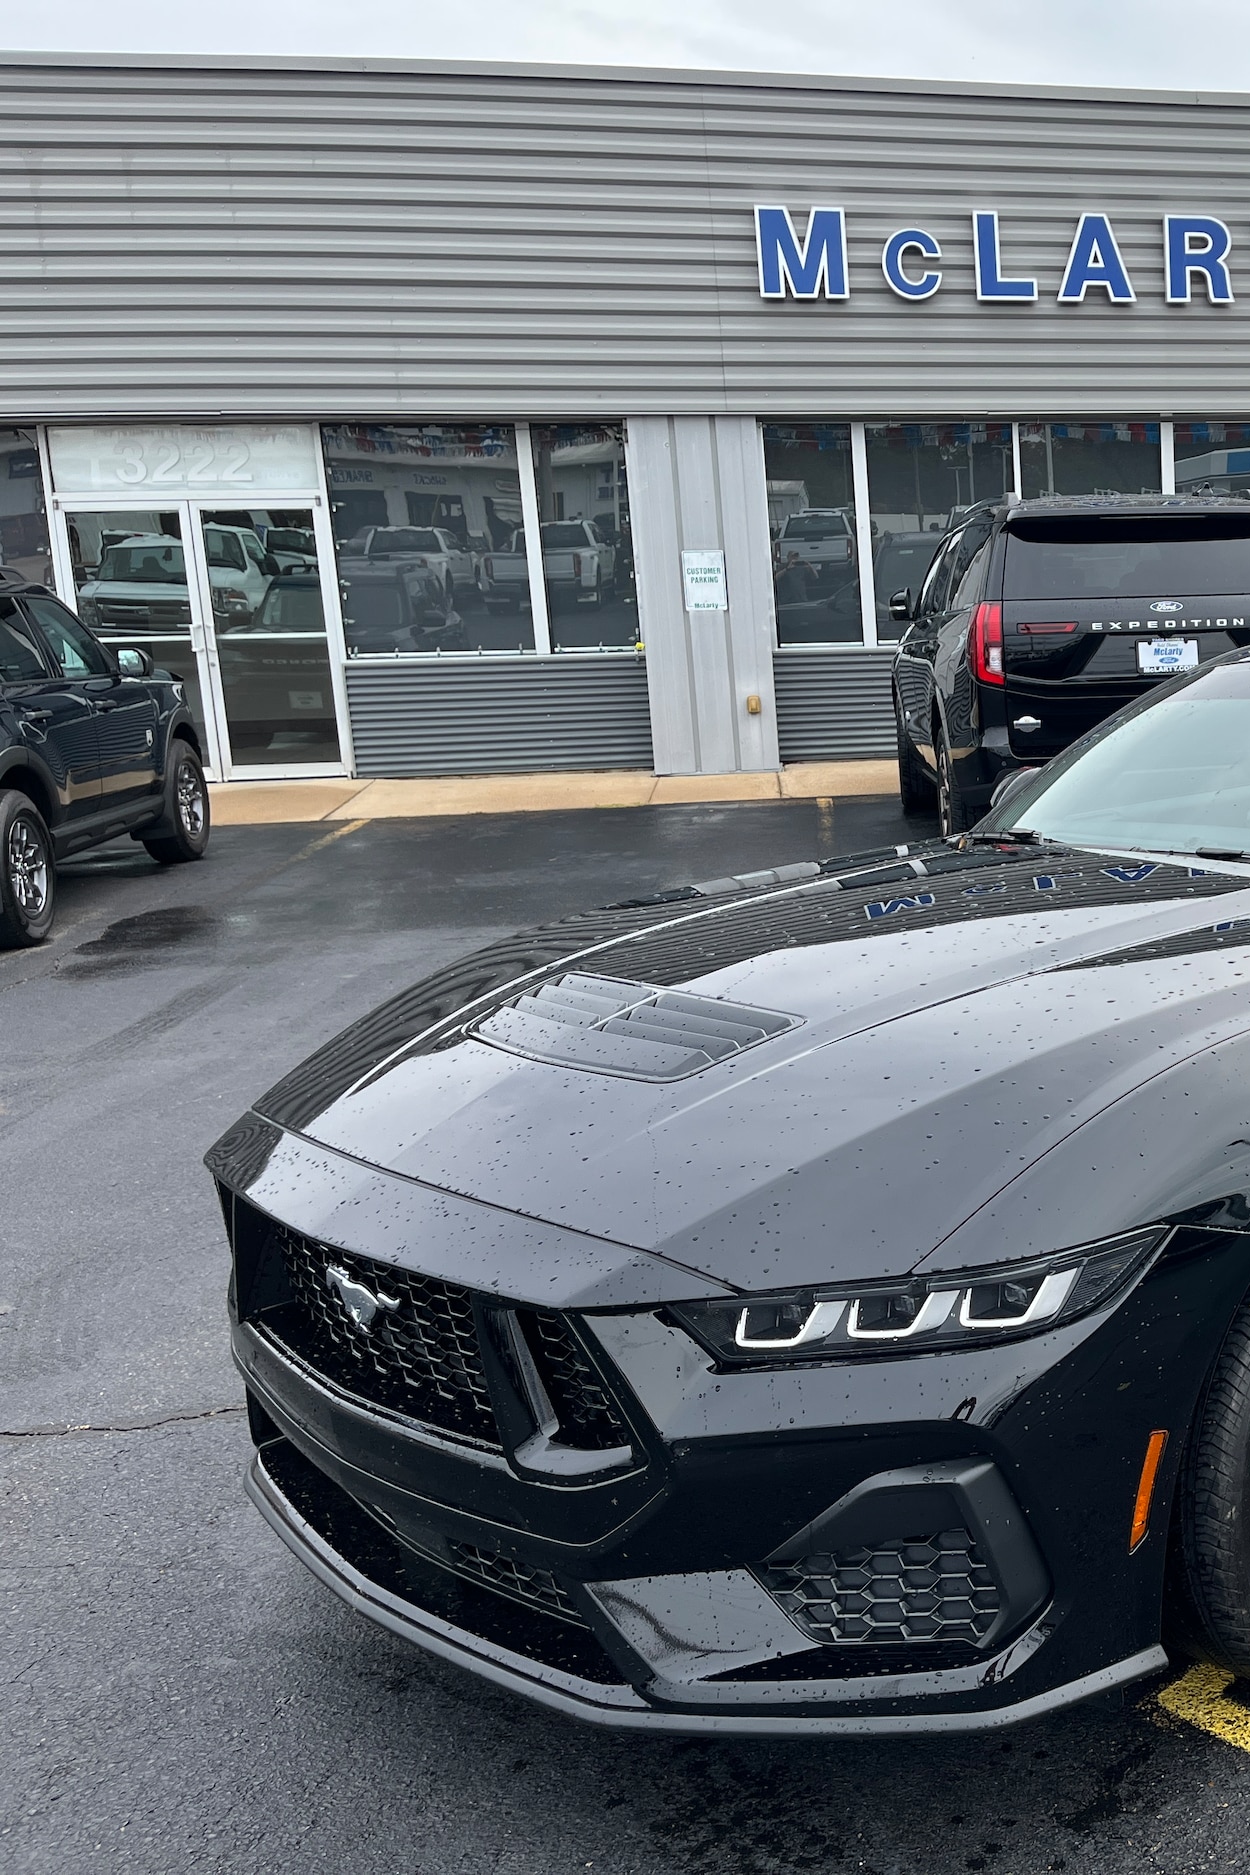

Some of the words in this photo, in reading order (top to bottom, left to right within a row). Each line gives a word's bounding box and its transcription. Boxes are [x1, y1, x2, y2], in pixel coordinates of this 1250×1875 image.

[686, 567, 721, 575] CUSTOMER
[1091, 617, 1245, 631] EXPEDITION
[1153, 647, 1184, 656] McLarty
